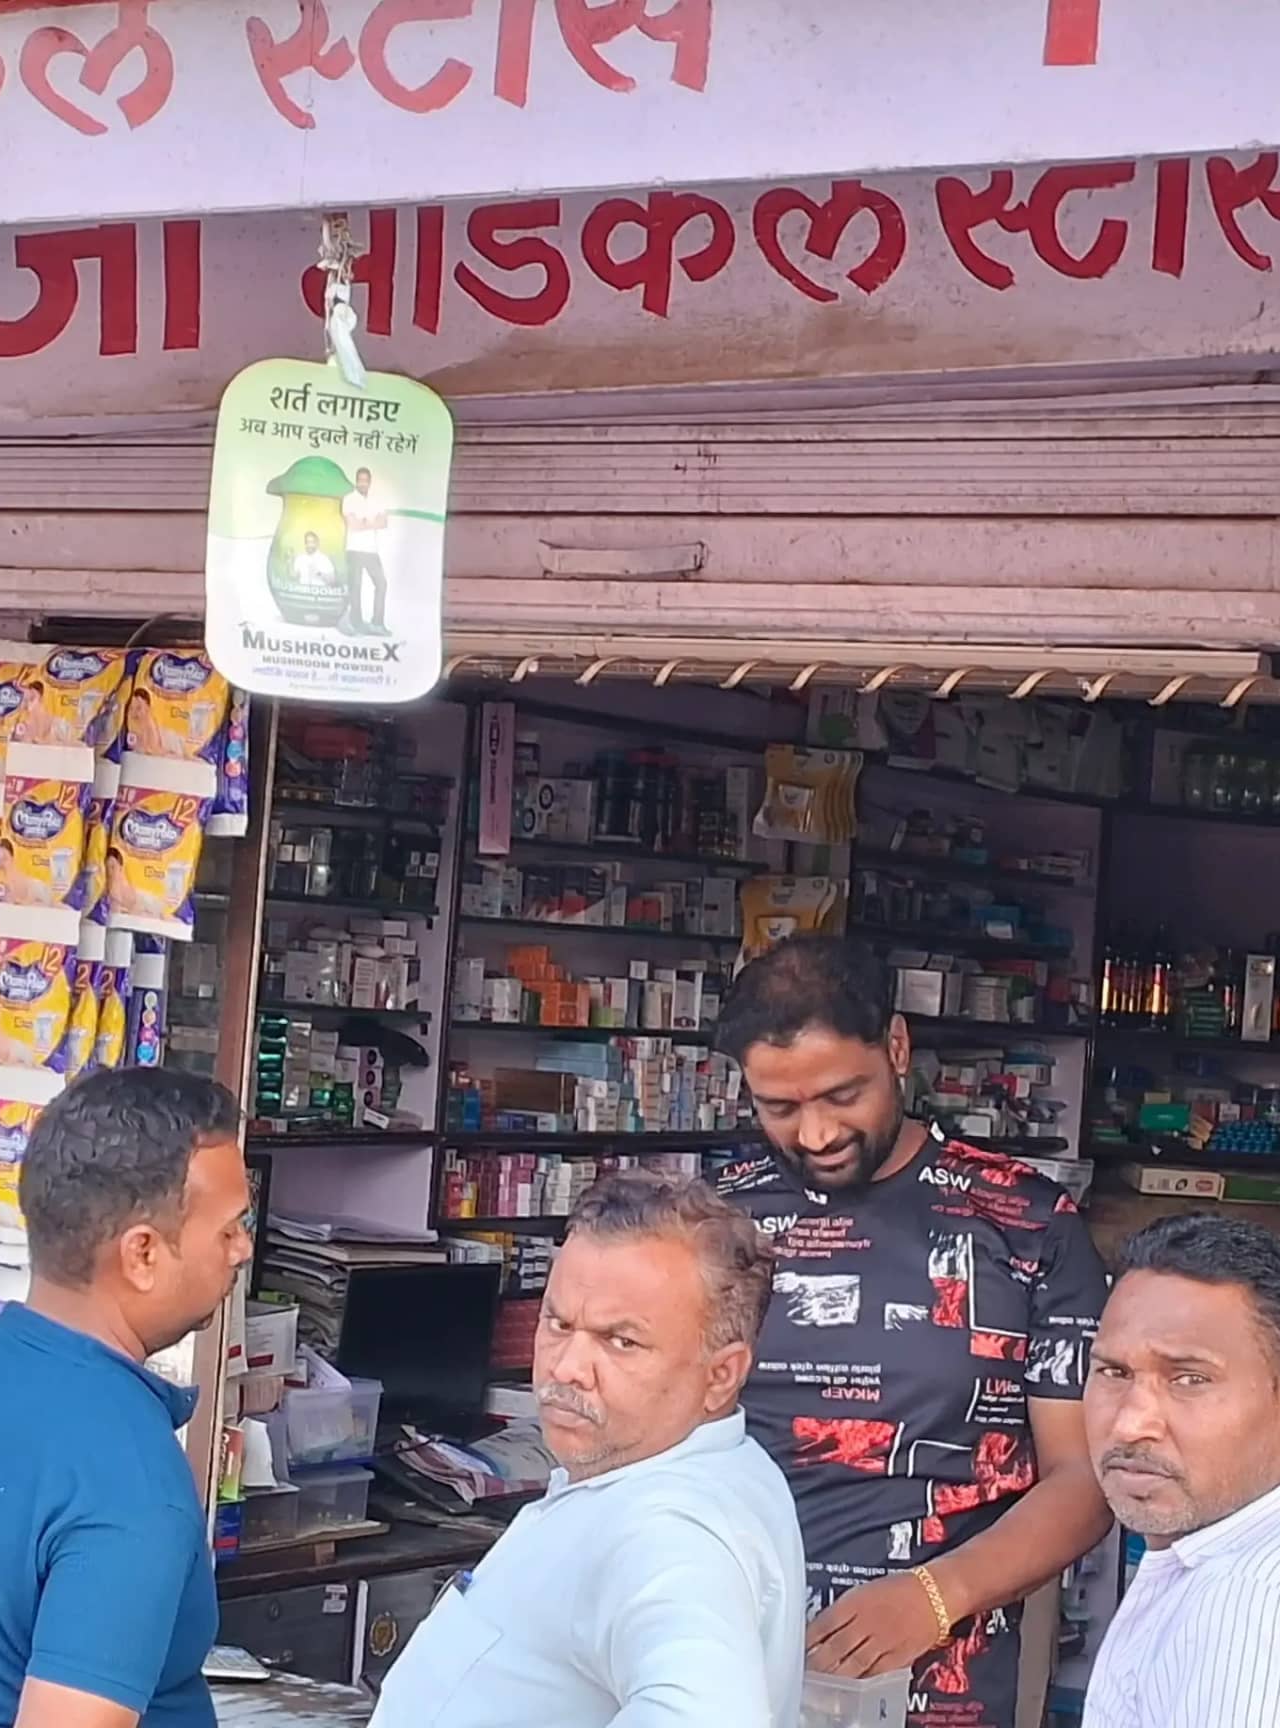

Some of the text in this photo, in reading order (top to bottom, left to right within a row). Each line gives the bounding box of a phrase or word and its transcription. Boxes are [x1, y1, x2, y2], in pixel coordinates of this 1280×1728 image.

[270, 383, 401, 423] शर्त लगाइए
[270, 421, 303, 440] आप
[262, 655, 384, 674] MUSHROOM POWDER
[918, 1166, 971, 1191] ASW
